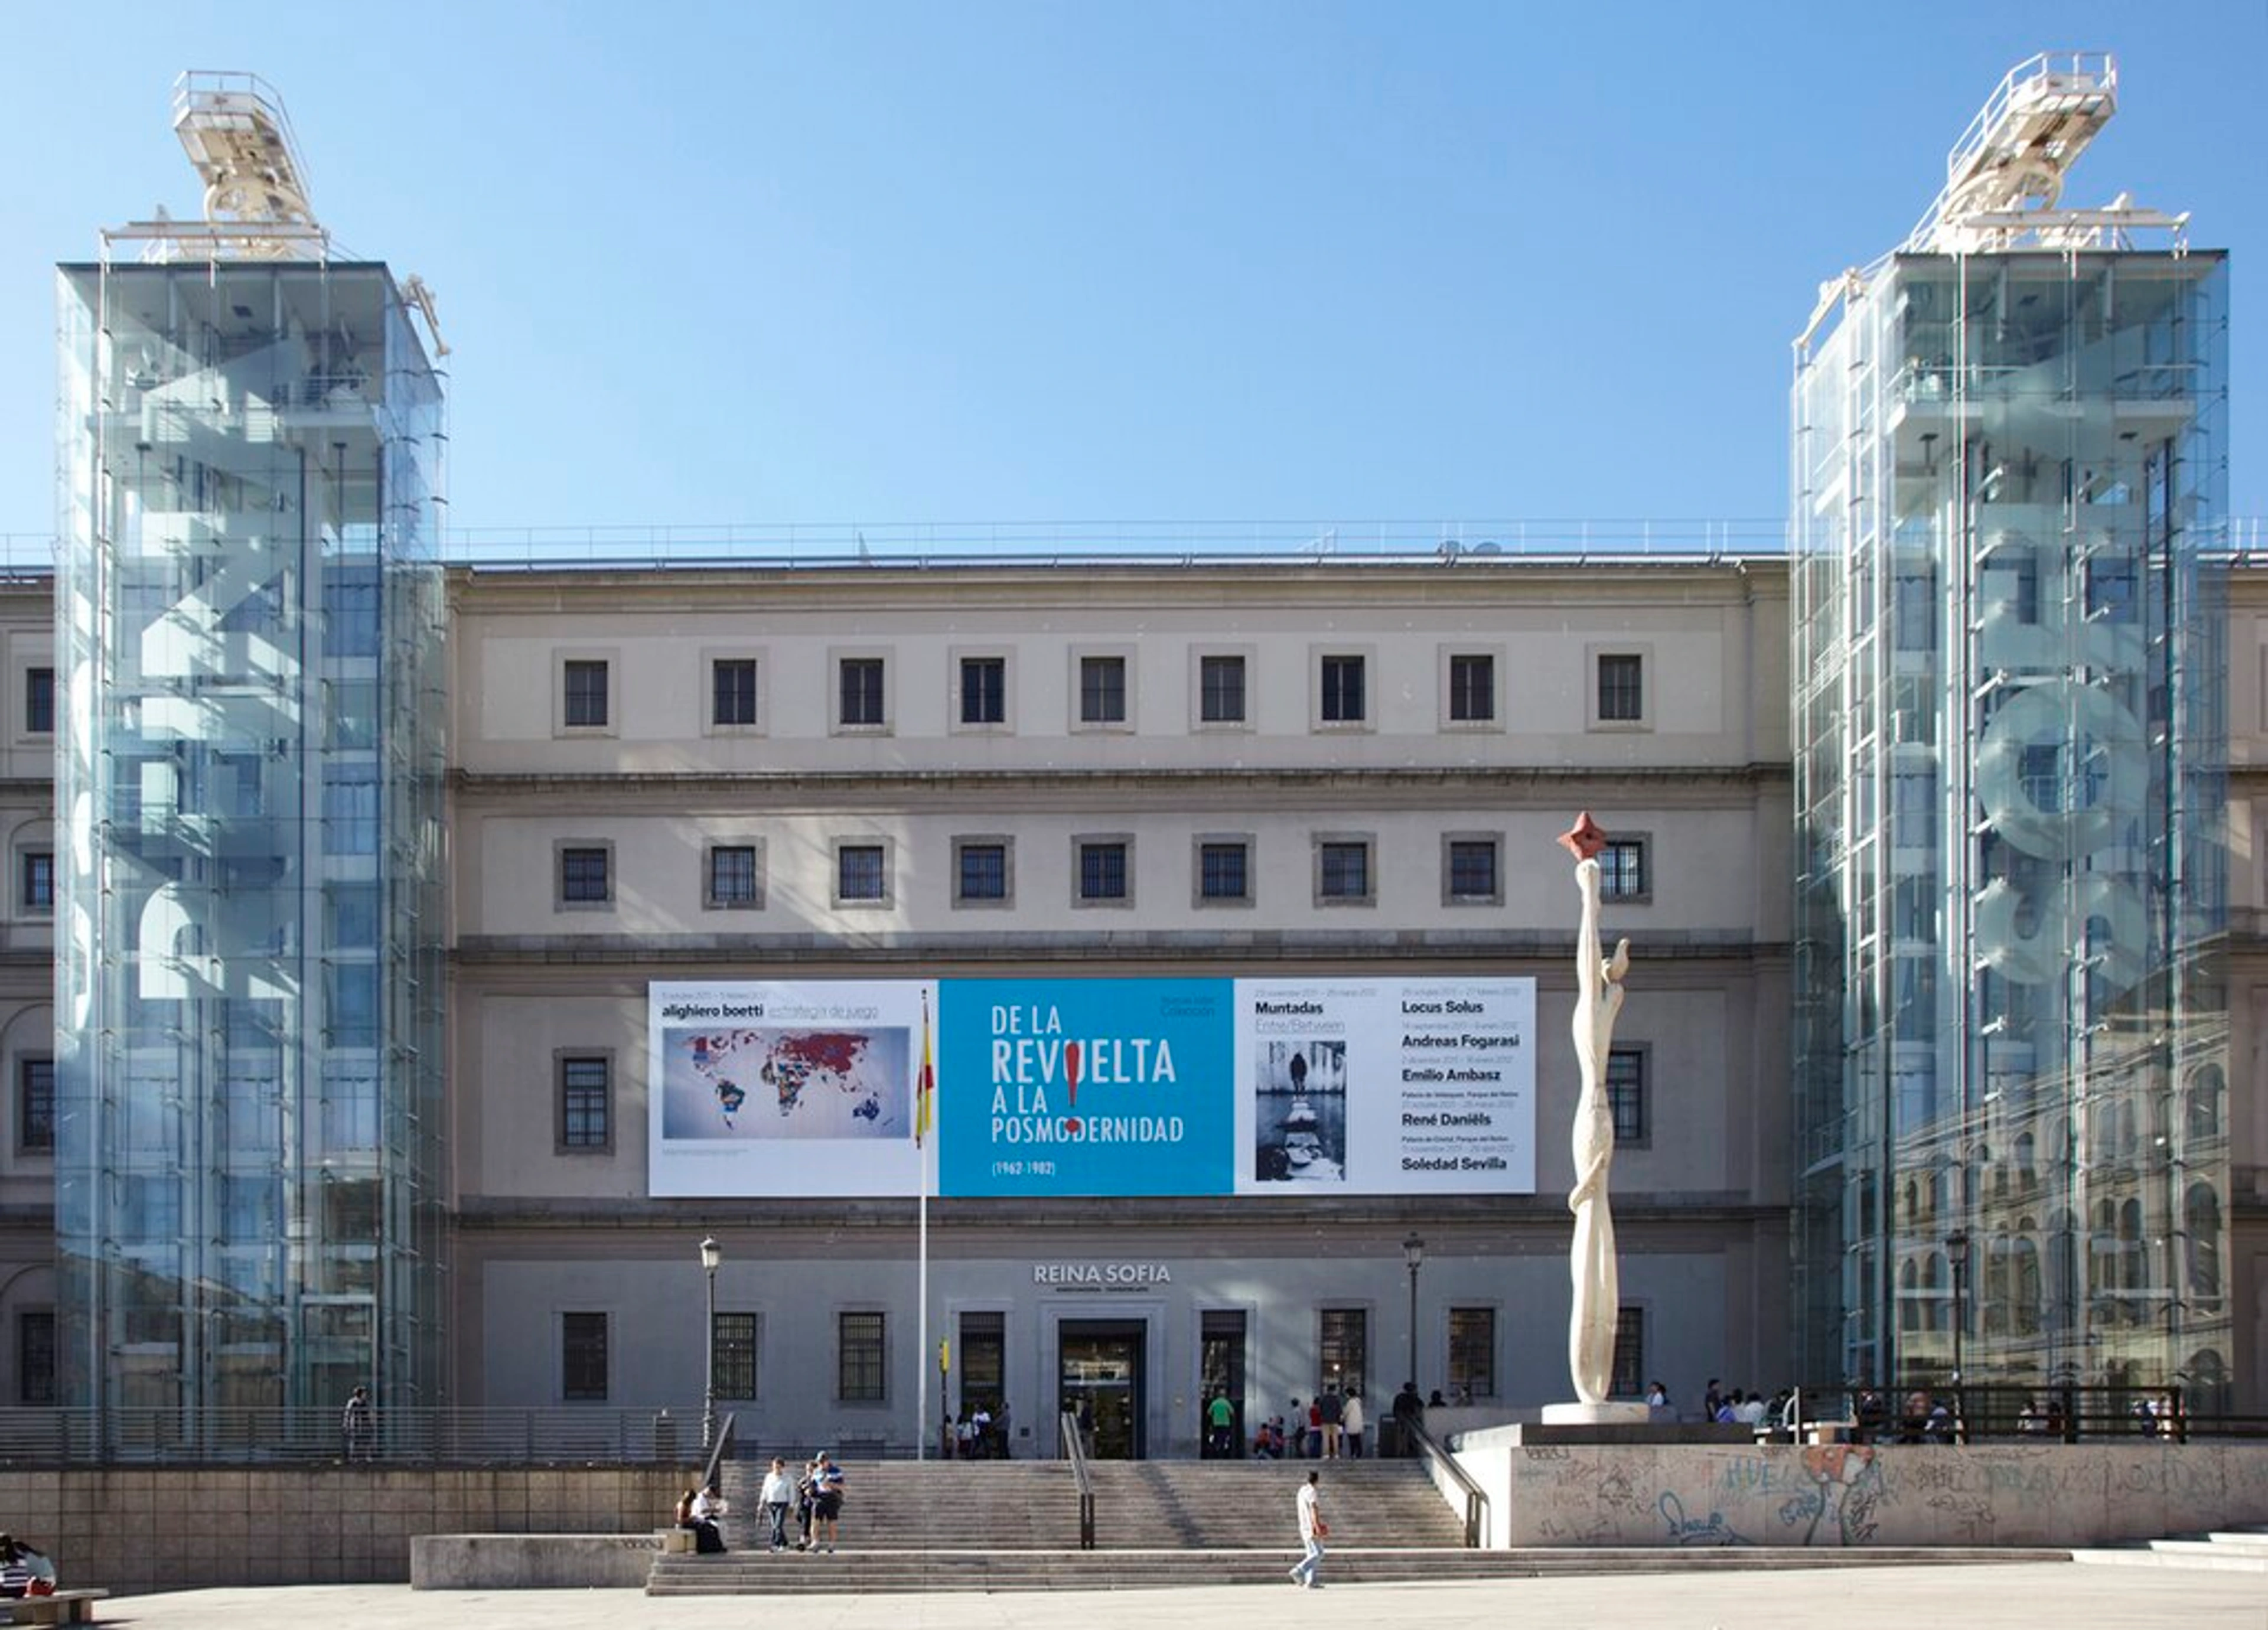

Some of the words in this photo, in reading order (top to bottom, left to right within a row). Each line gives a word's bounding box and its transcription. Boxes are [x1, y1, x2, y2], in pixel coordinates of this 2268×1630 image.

[662, 1004, 720, 1019] alighiero
[722, 1003, 764, 1017] boetti
[1255, 1002, 1324, 1015] Muntadas
[1402, 1001, 1443, 1013] Locus
[1446, 1000, 1484, 1013] Solus
[992, 1005, 1022, 1034] DE
[1032, 1005, 1062, 1034] LA
[1402, 1035, 1458, 1047] Andreas
[1461, 1034, 1520, 1049] Fogarasi
[992, 1039, 1176, 1083] REVUELTA
[1402, 1069, 1444, 1081] Emilio
[1447, 1068, 1501, 1082] Ambasz
[992, 1085, 1007, 1114] A
[1018, 1085, 1047, 1114] LA
[1402, 1113, 1438, 1126] René
[992, 1117, 1184, 1143] POSMODERNIDAD
[1402, 1158, 1458, 1170] Soledad
[1461, 1158, 1507, 1170] Sevilla
[1034, 1264, 1102, 1282] REINA
[1106, 1264, 1171, 1282] SOFIA
